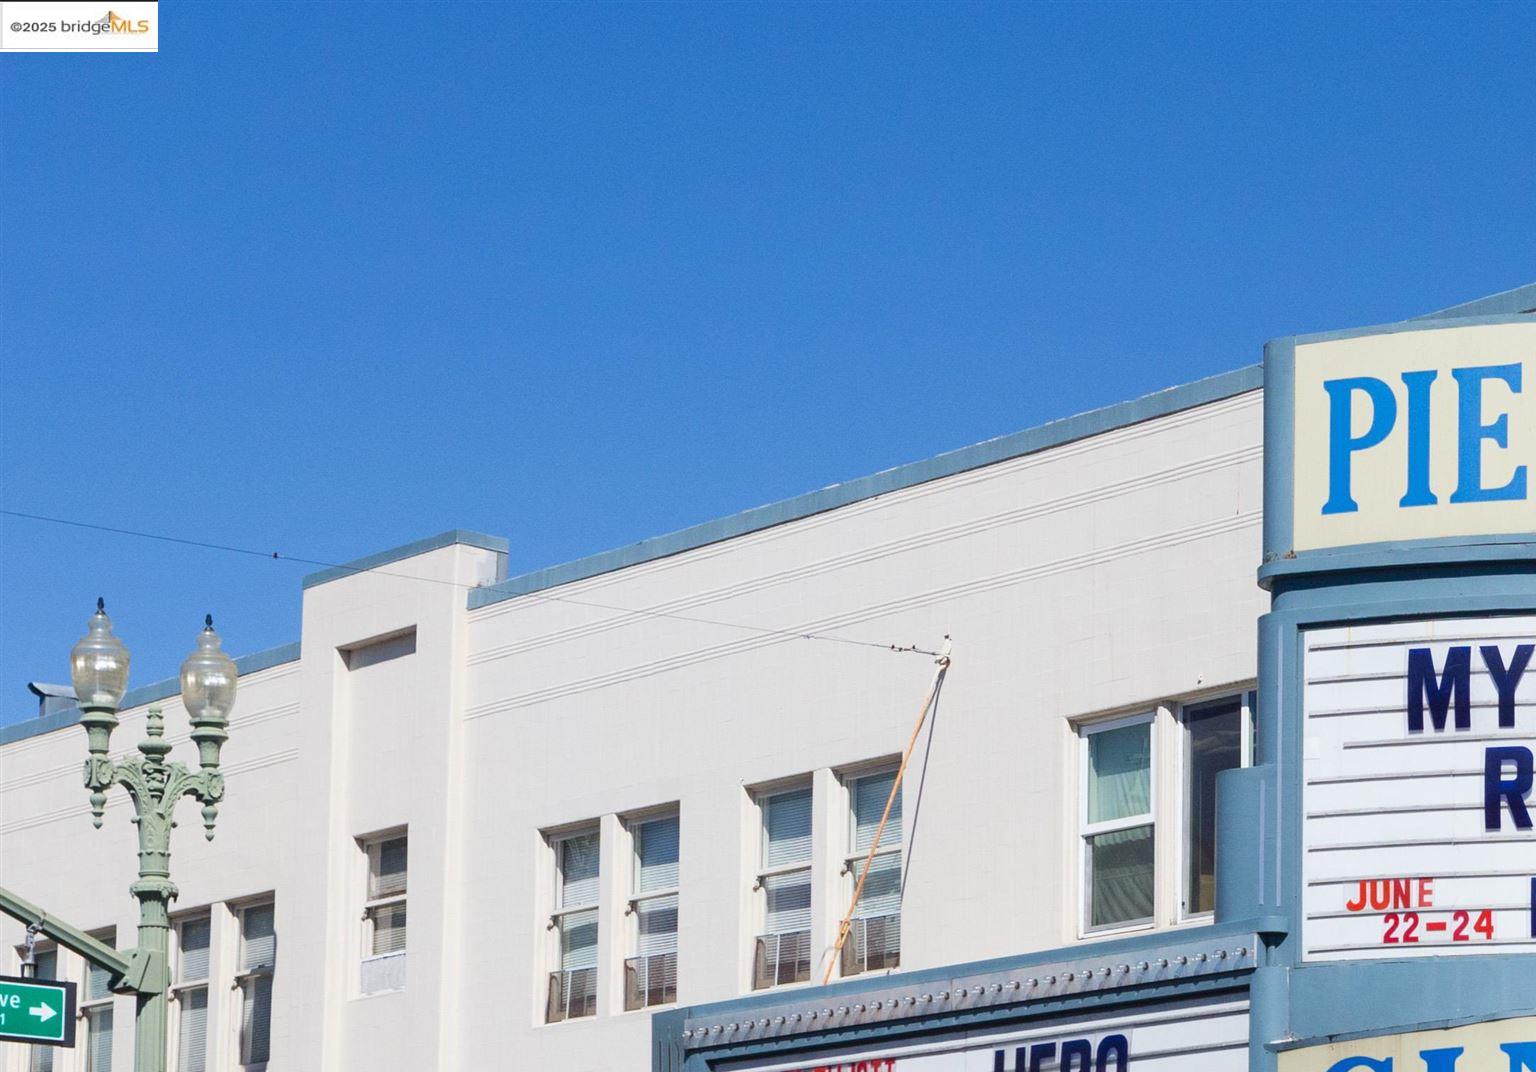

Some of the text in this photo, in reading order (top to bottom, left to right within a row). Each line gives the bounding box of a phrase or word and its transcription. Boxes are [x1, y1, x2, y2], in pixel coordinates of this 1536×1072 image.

[1406, 643, 1535, 732] MY
[1346, 877, 1434, 912] JUNE
[1382, 908, 1495, 944] 22-24
[0, 994, 21, 1009] ve
